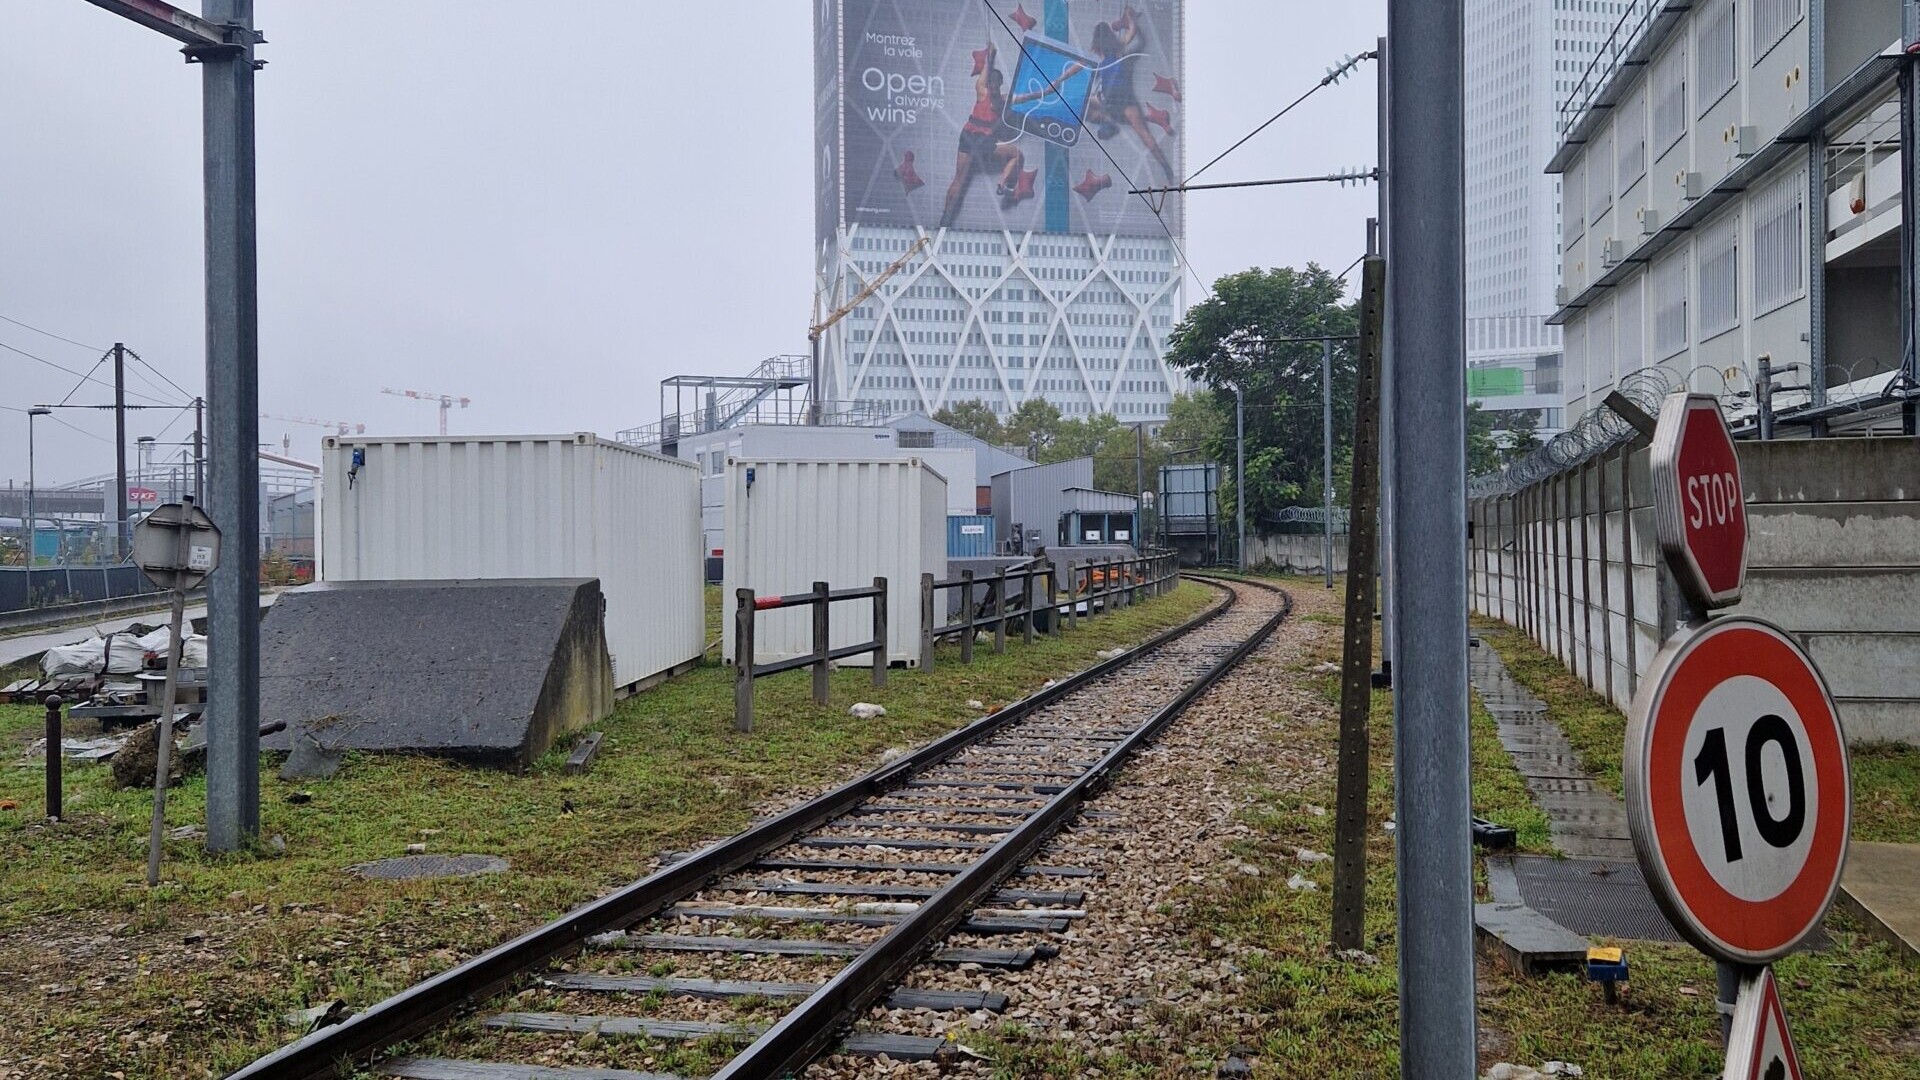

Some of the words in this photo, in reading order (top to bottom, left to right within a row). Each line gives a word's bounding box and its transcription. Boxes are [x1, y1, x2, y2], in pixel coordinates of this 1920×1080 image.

[865, 31, 916, 46] Montrez
[884, 45, 896, 56] la
[862, 66, 945, 101] Open
[867, 103, 917, 124] wins
[895, 94, 945, 112] always
[1687, 472, 1737, 530] STOP
[1694, 714, 1806, 864] 10
